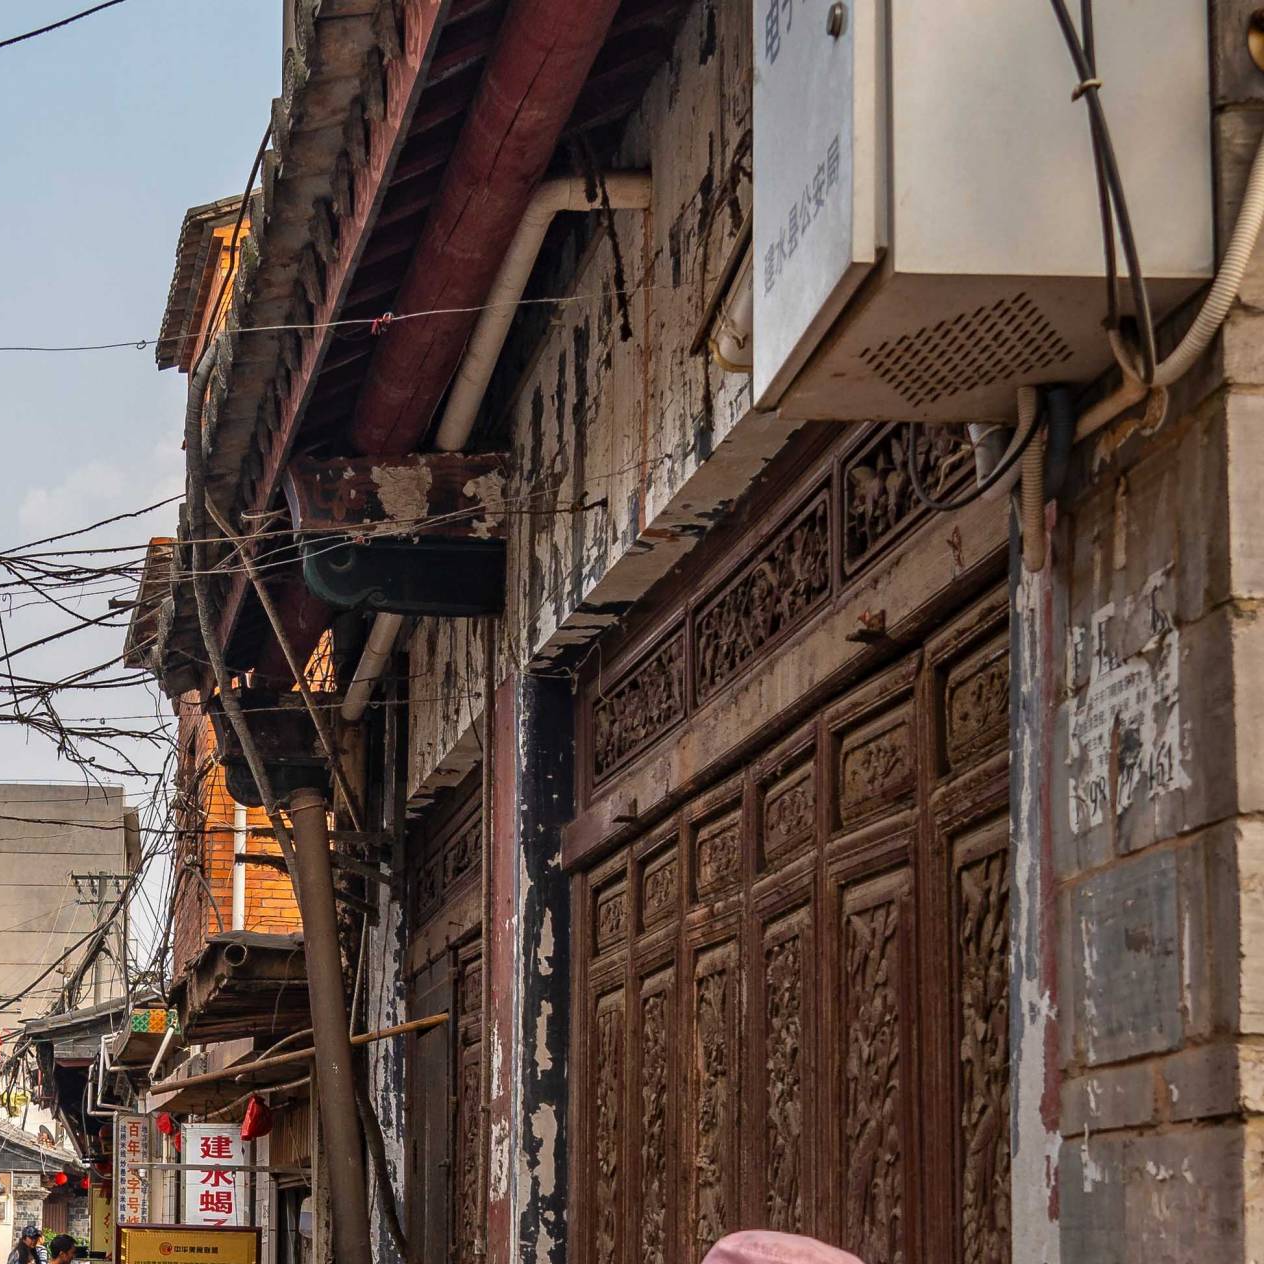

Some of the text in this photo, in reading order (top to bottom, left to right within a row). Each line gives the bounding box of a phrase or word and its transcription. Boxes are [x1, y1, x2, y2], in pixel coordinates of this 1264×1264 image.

[764, 133, 840, 298] 建水县公安局
